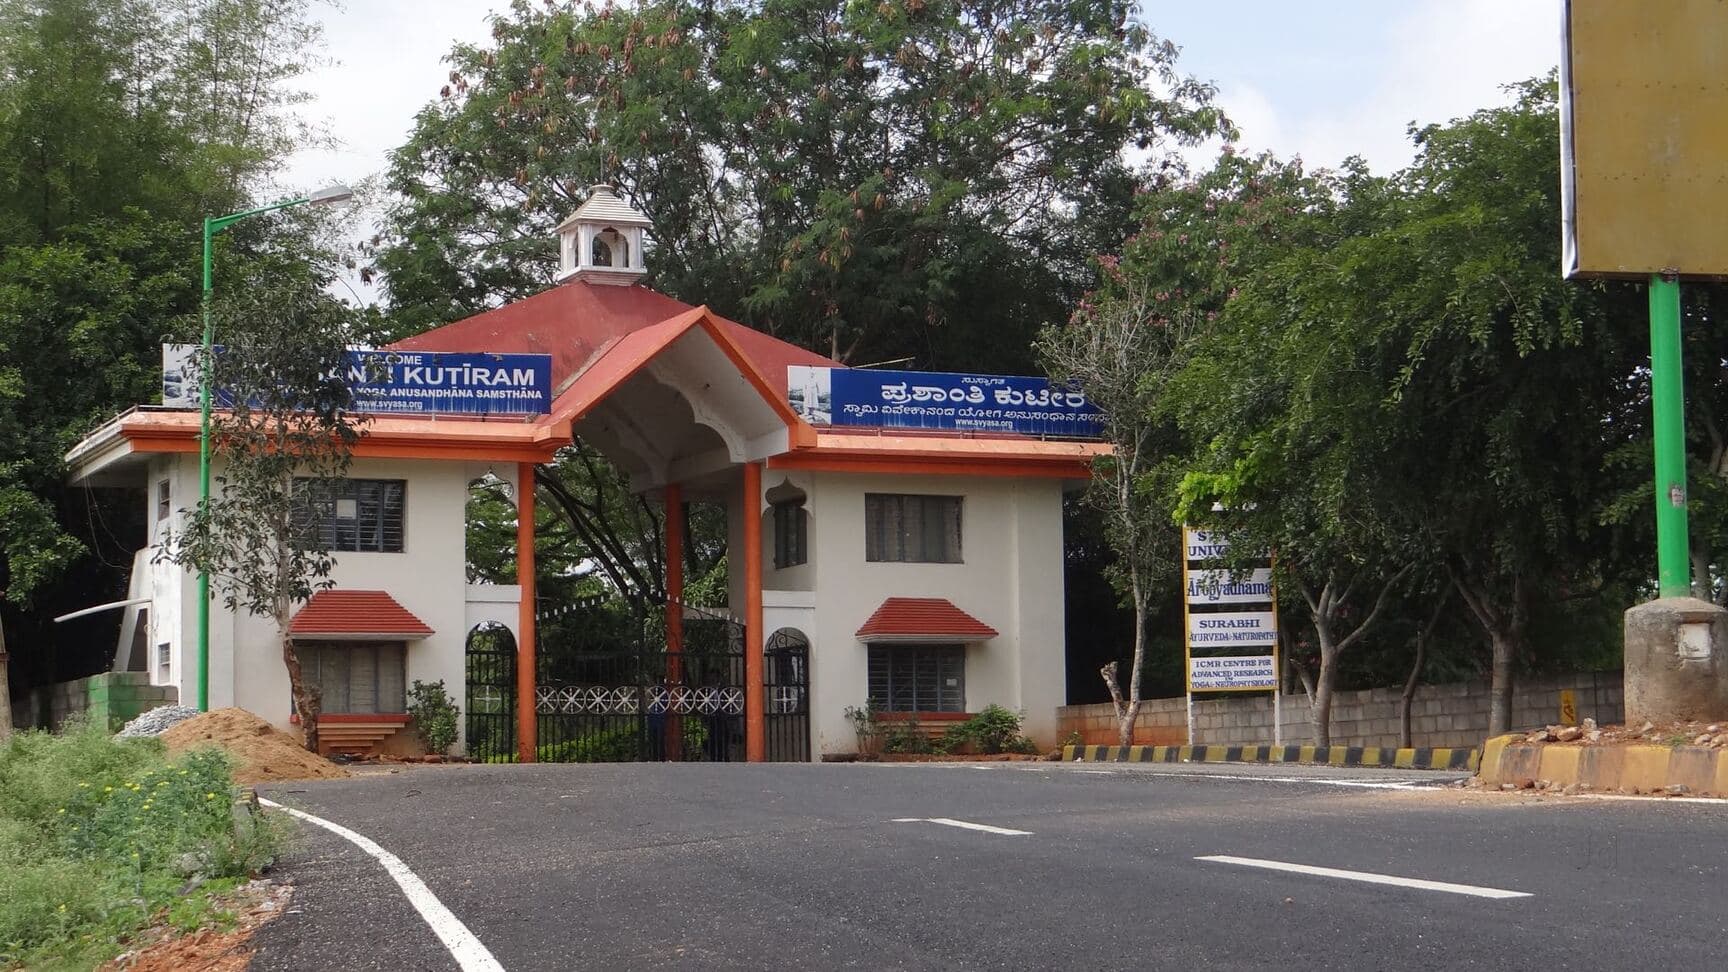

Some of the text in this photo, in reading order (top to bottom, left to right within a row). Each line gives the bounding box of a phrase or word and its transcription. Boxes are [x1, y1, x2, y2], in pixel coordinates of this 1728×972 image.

[404, 363, 535, 386] KUTĪRAM
[390, 386, 473, 398] ANUSANDHĀNA
[476, 387, 543, 399] SAMSTHĀNA
[881, 381, 1085, 408] ಪ್ರಶಾಂತಿ ಕುಟೀರ
[843, 403, 879, 417] ಸ್ವಾಮಿ
[881, 404, 955, 416] ವಿವೇಕಾನಂದ
[958, 406, 1002, 418] ಯೋಗ
[955, 418, 1013, 430] www.svyasa.org
[1199, 619, 1260, 629] SURABHI
[1196, 660, 1221, 668] ICMR
[1192, 669, 1273, 678] ADVANCED RESEARCH
